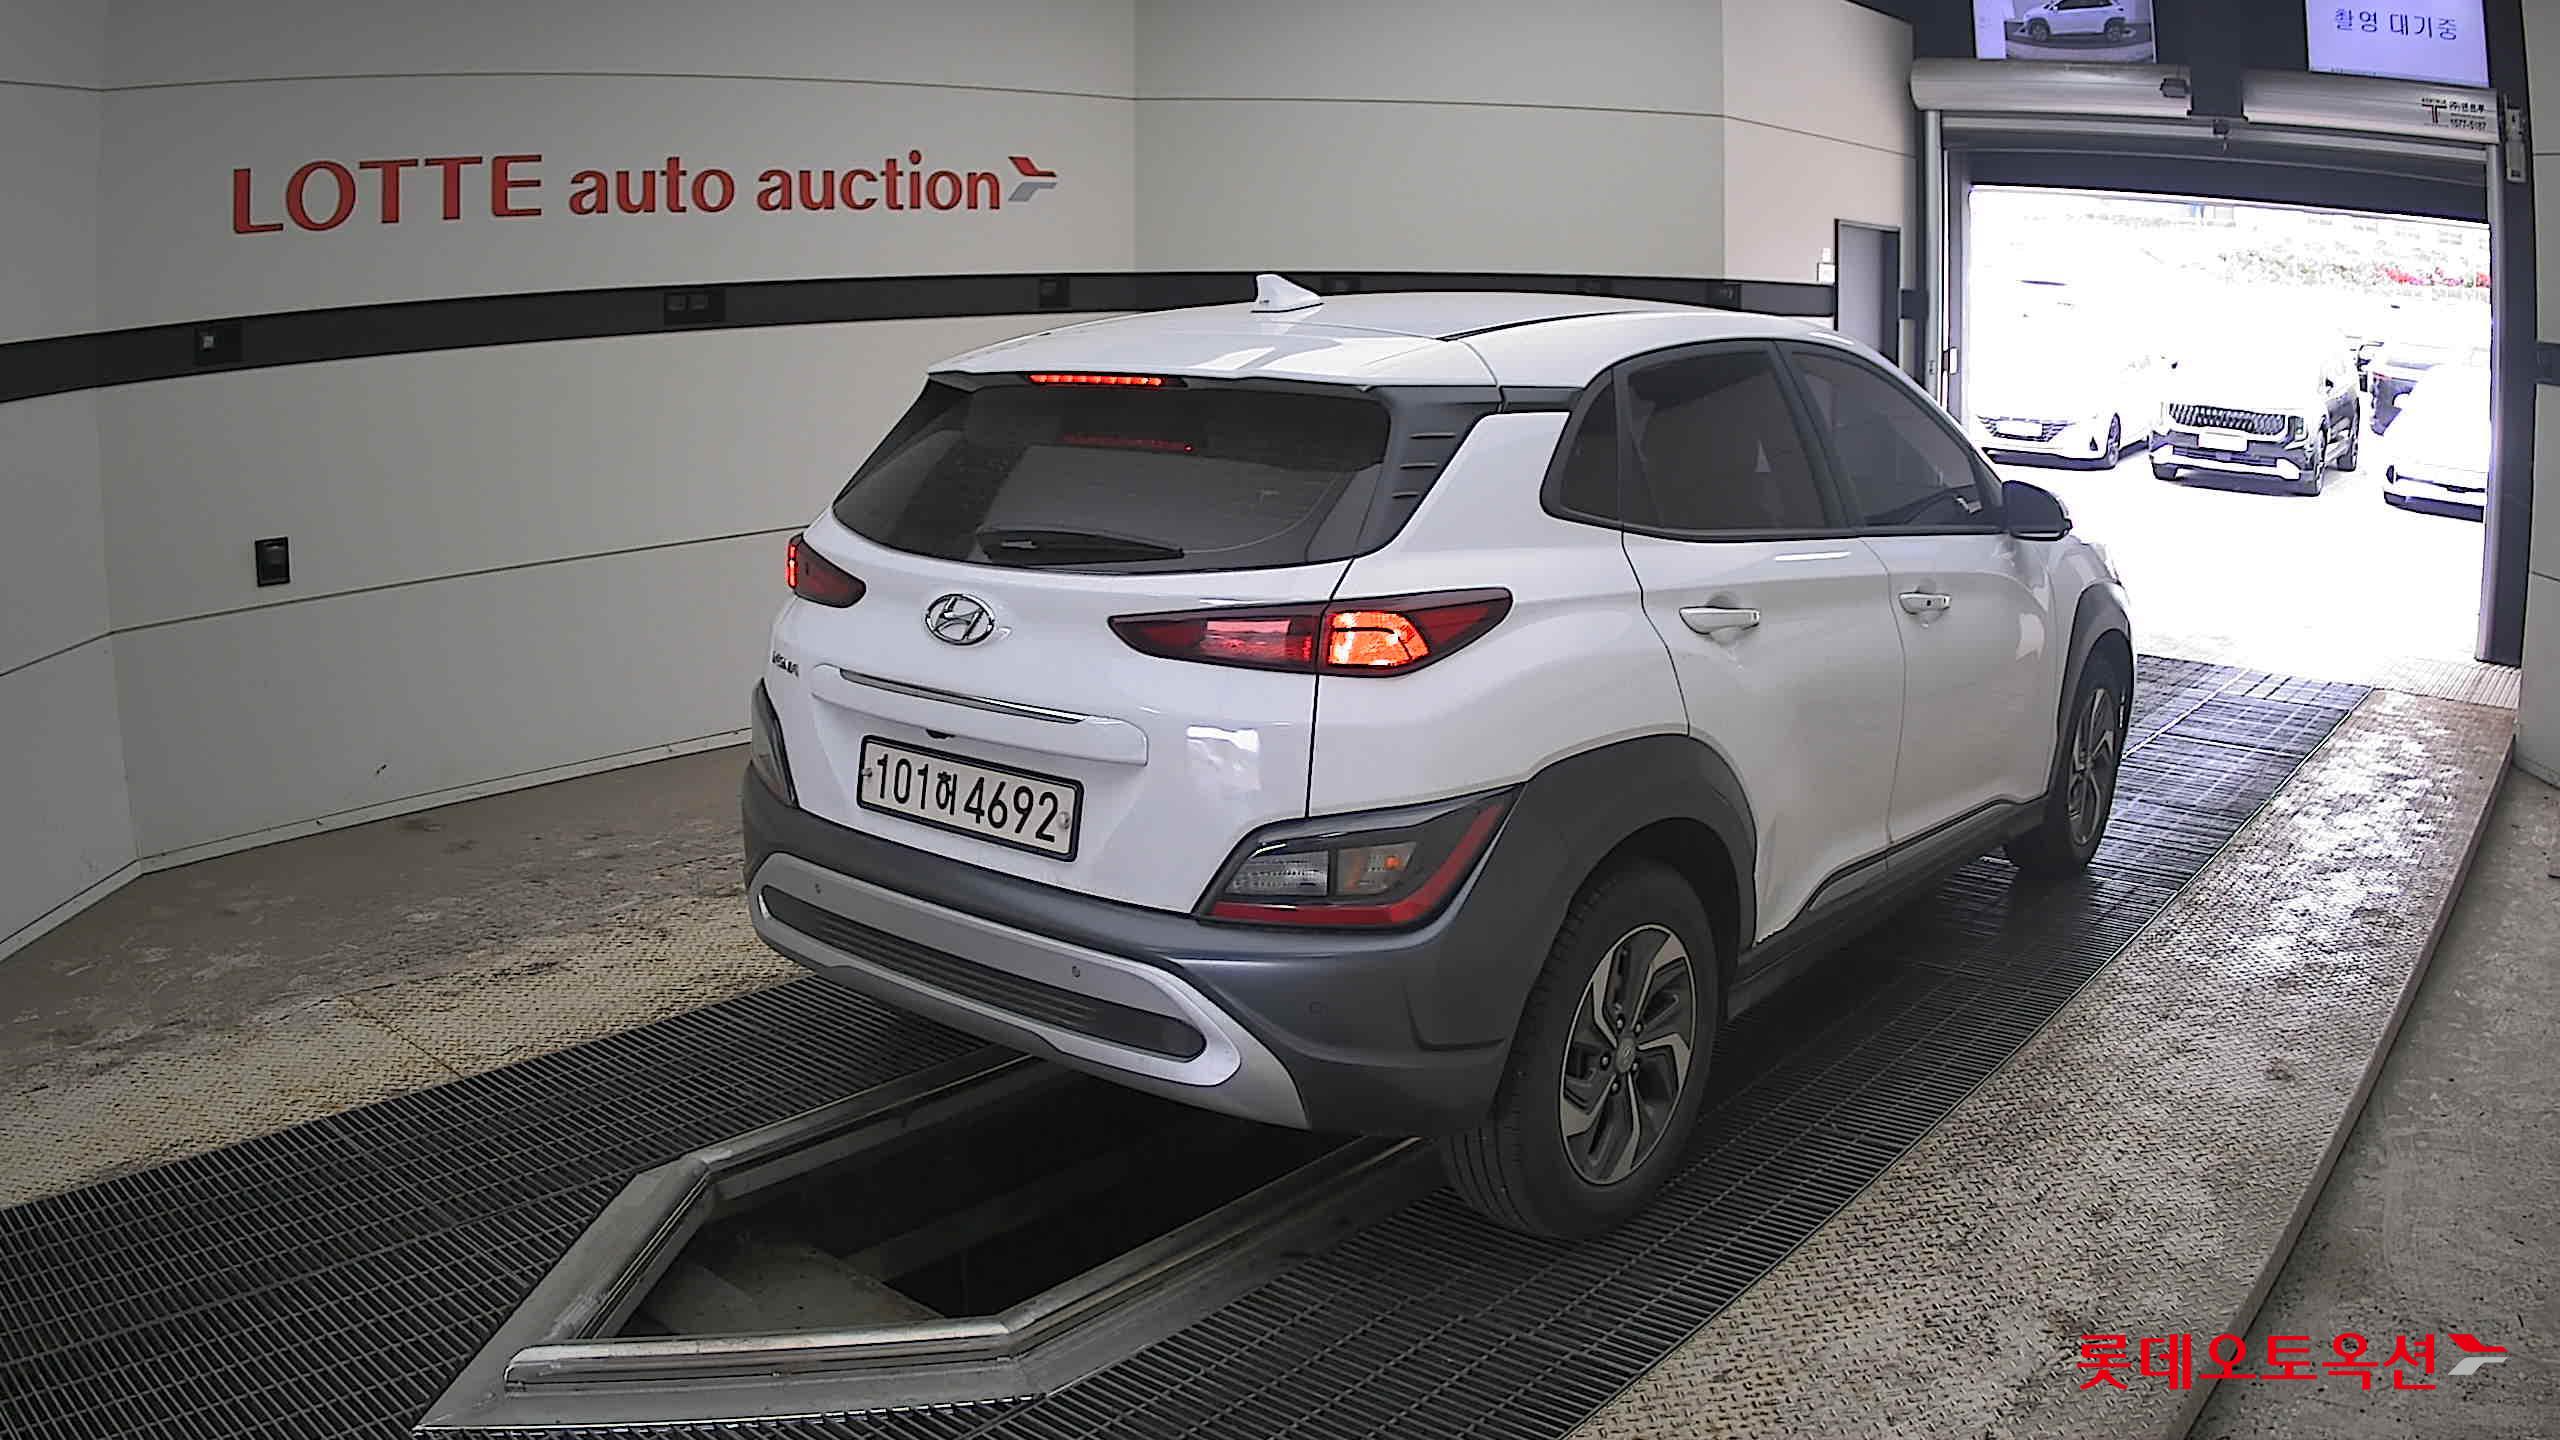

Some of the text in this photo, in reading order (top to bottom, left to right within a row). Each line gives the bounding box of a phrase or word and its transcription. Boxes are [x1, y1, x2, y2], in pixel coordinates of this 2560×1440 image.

[2335, 8, 2458, 41] 촬영 대기중
[233, 150, 1001, 235] LOTTE auto auction
[877, 753, 1060, 843] 101허4692
